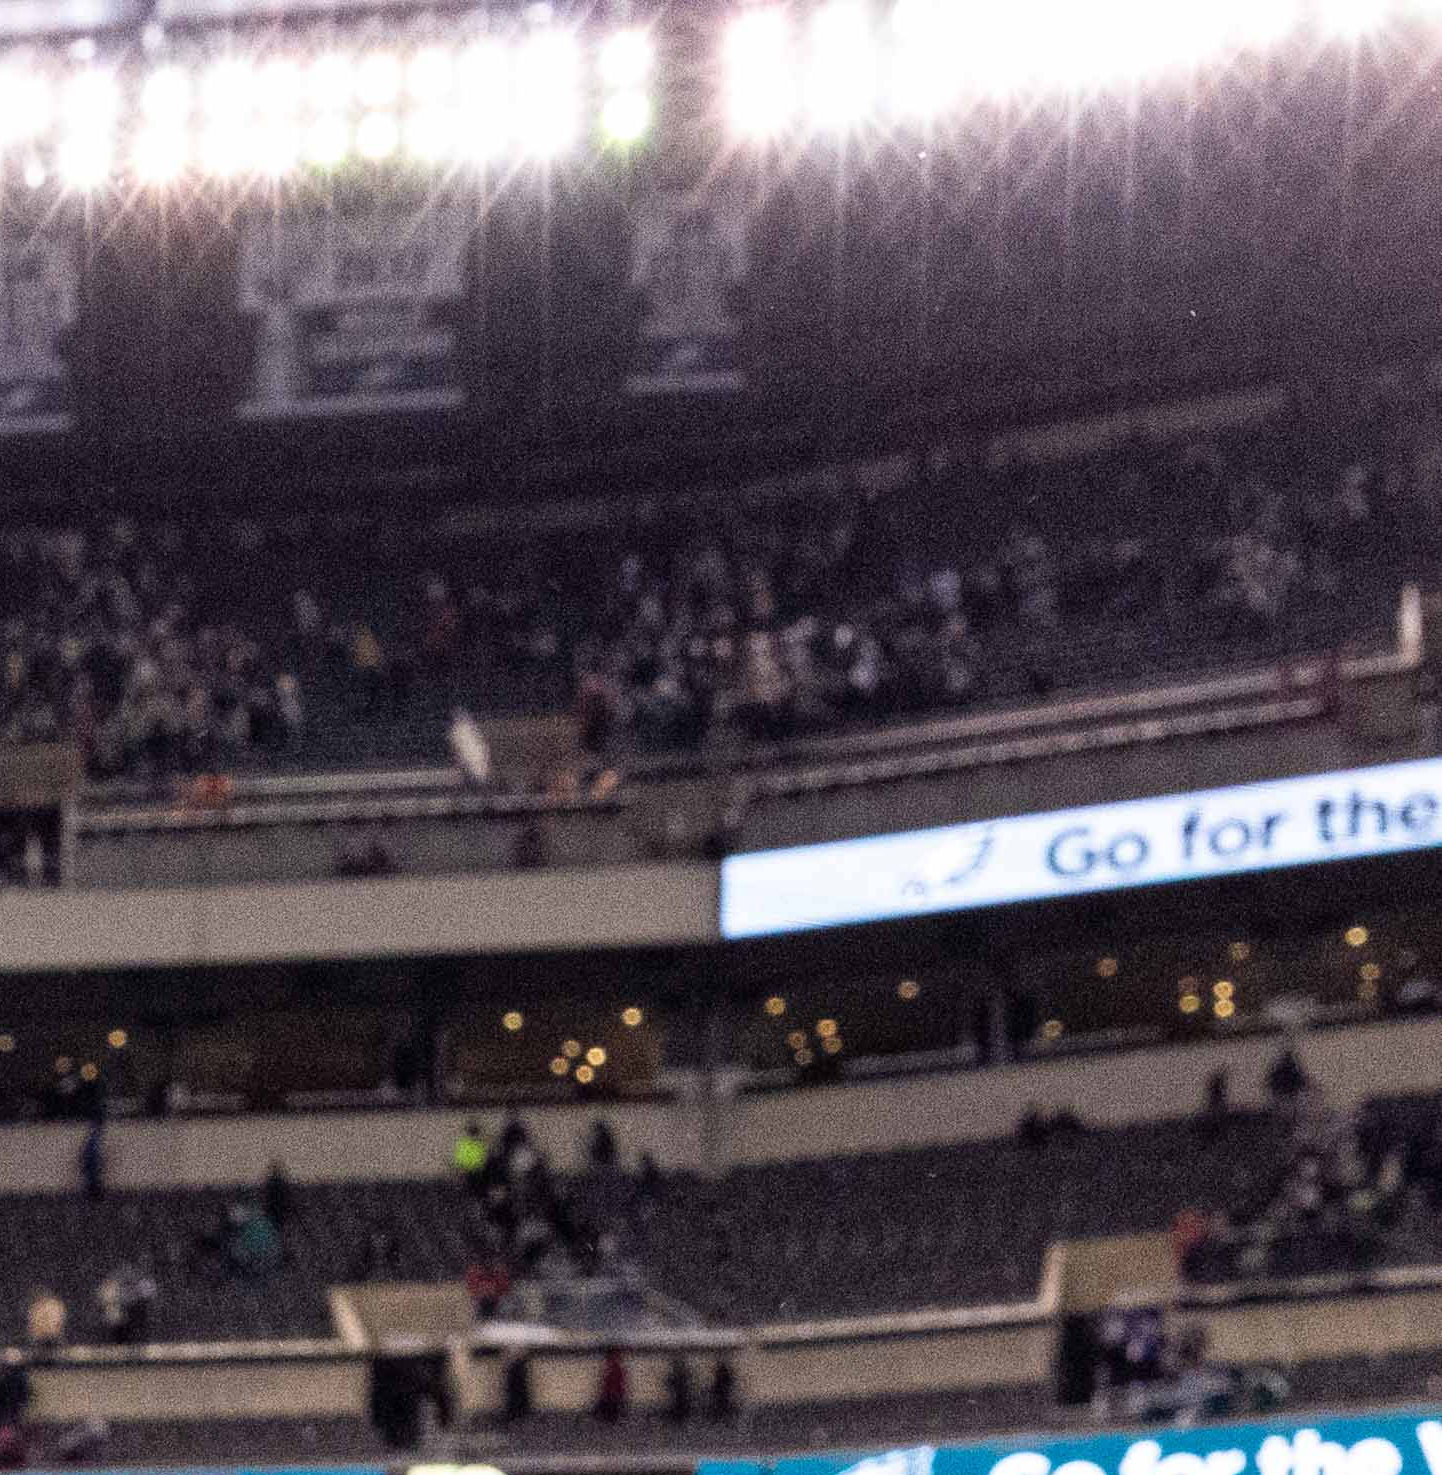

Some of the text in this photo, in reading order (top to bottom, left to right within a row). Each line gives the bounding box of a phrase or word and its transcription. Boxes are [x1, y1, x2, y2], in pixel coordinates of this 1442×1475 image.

[1046, 788, 1442, 877] Go for the
